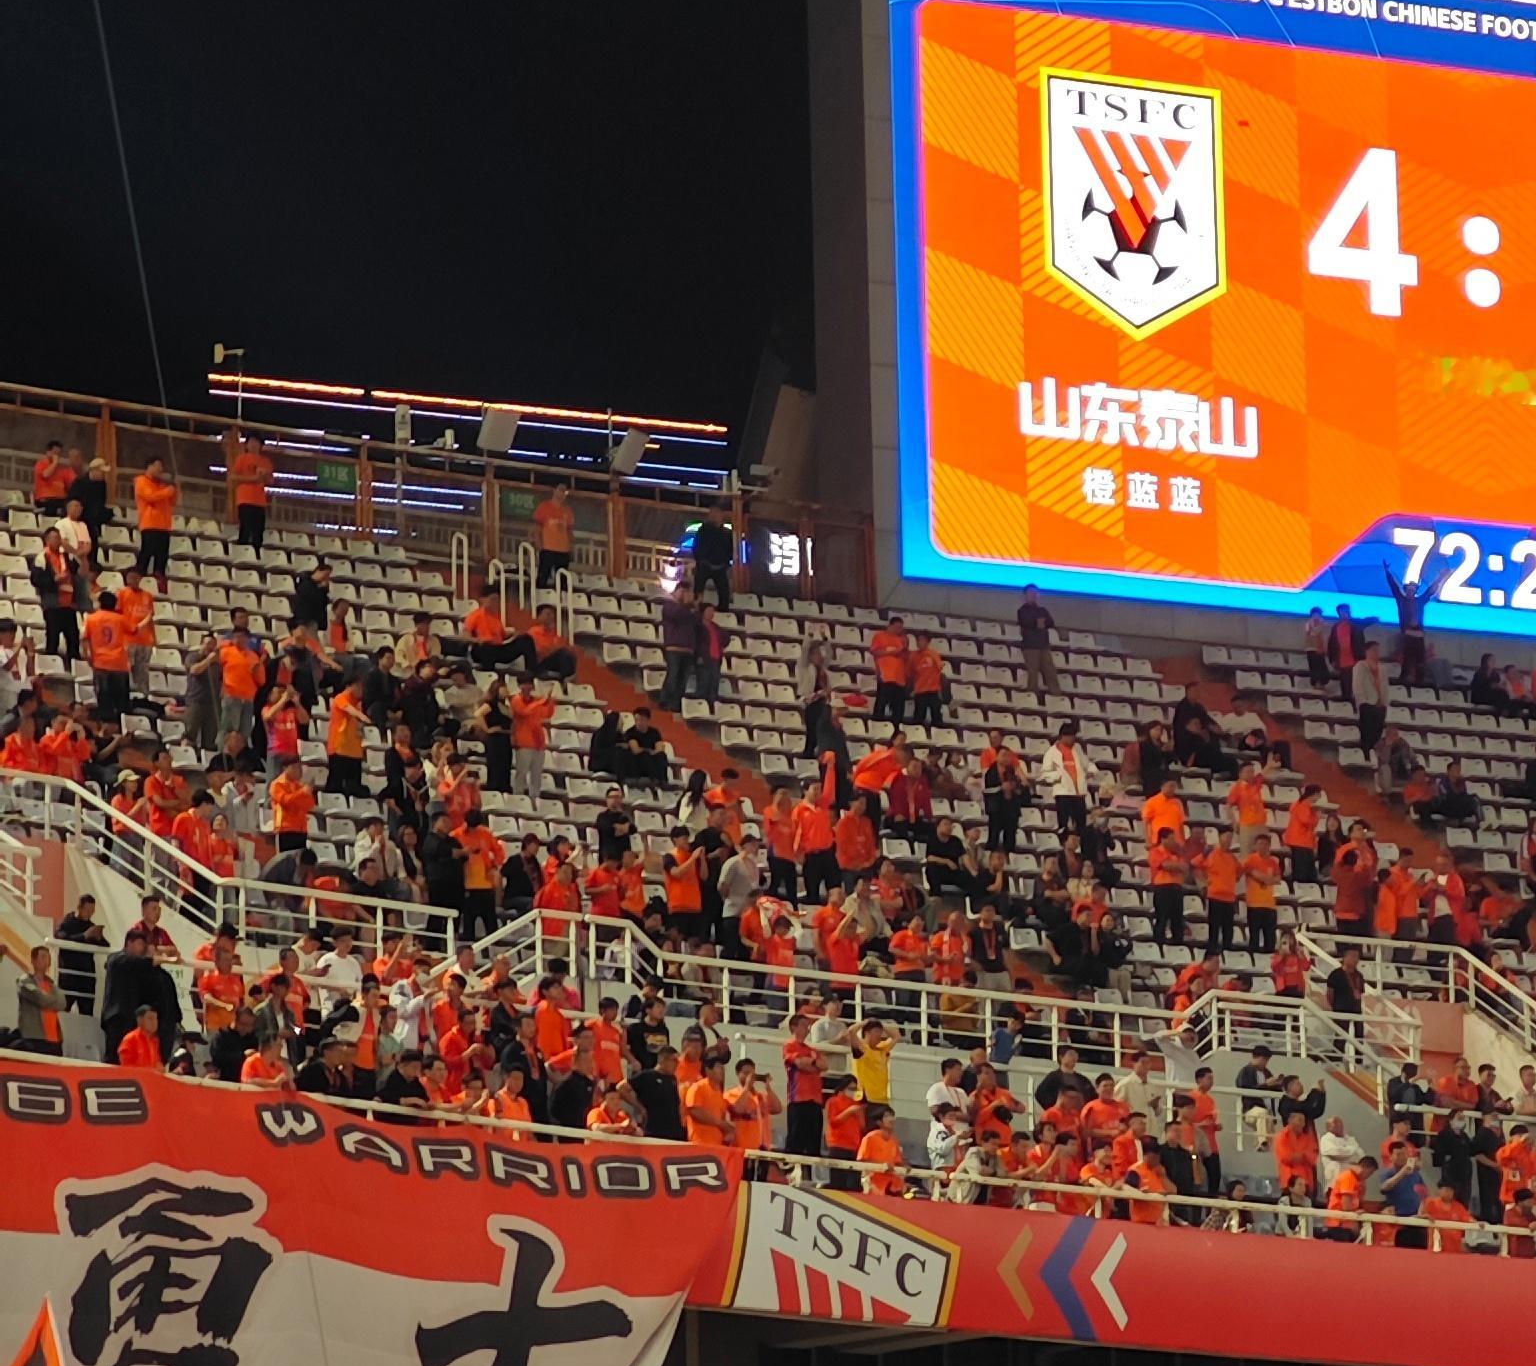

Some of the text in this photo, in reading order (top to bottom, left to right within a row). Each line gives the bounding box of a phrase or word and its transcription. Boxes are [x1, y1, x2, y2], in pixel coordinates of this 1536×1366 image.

[1382, 0, 1476, 34] CHINESE
[1066, 88, 1197, 130] TSFC
[1307, 146, 1419, 317] 4
[1018, 375, 1259, 459] 山东泰山
[261, 1109, 724, 1193] WARRIOR
[769, 1189, 927, 1298] TSFC
